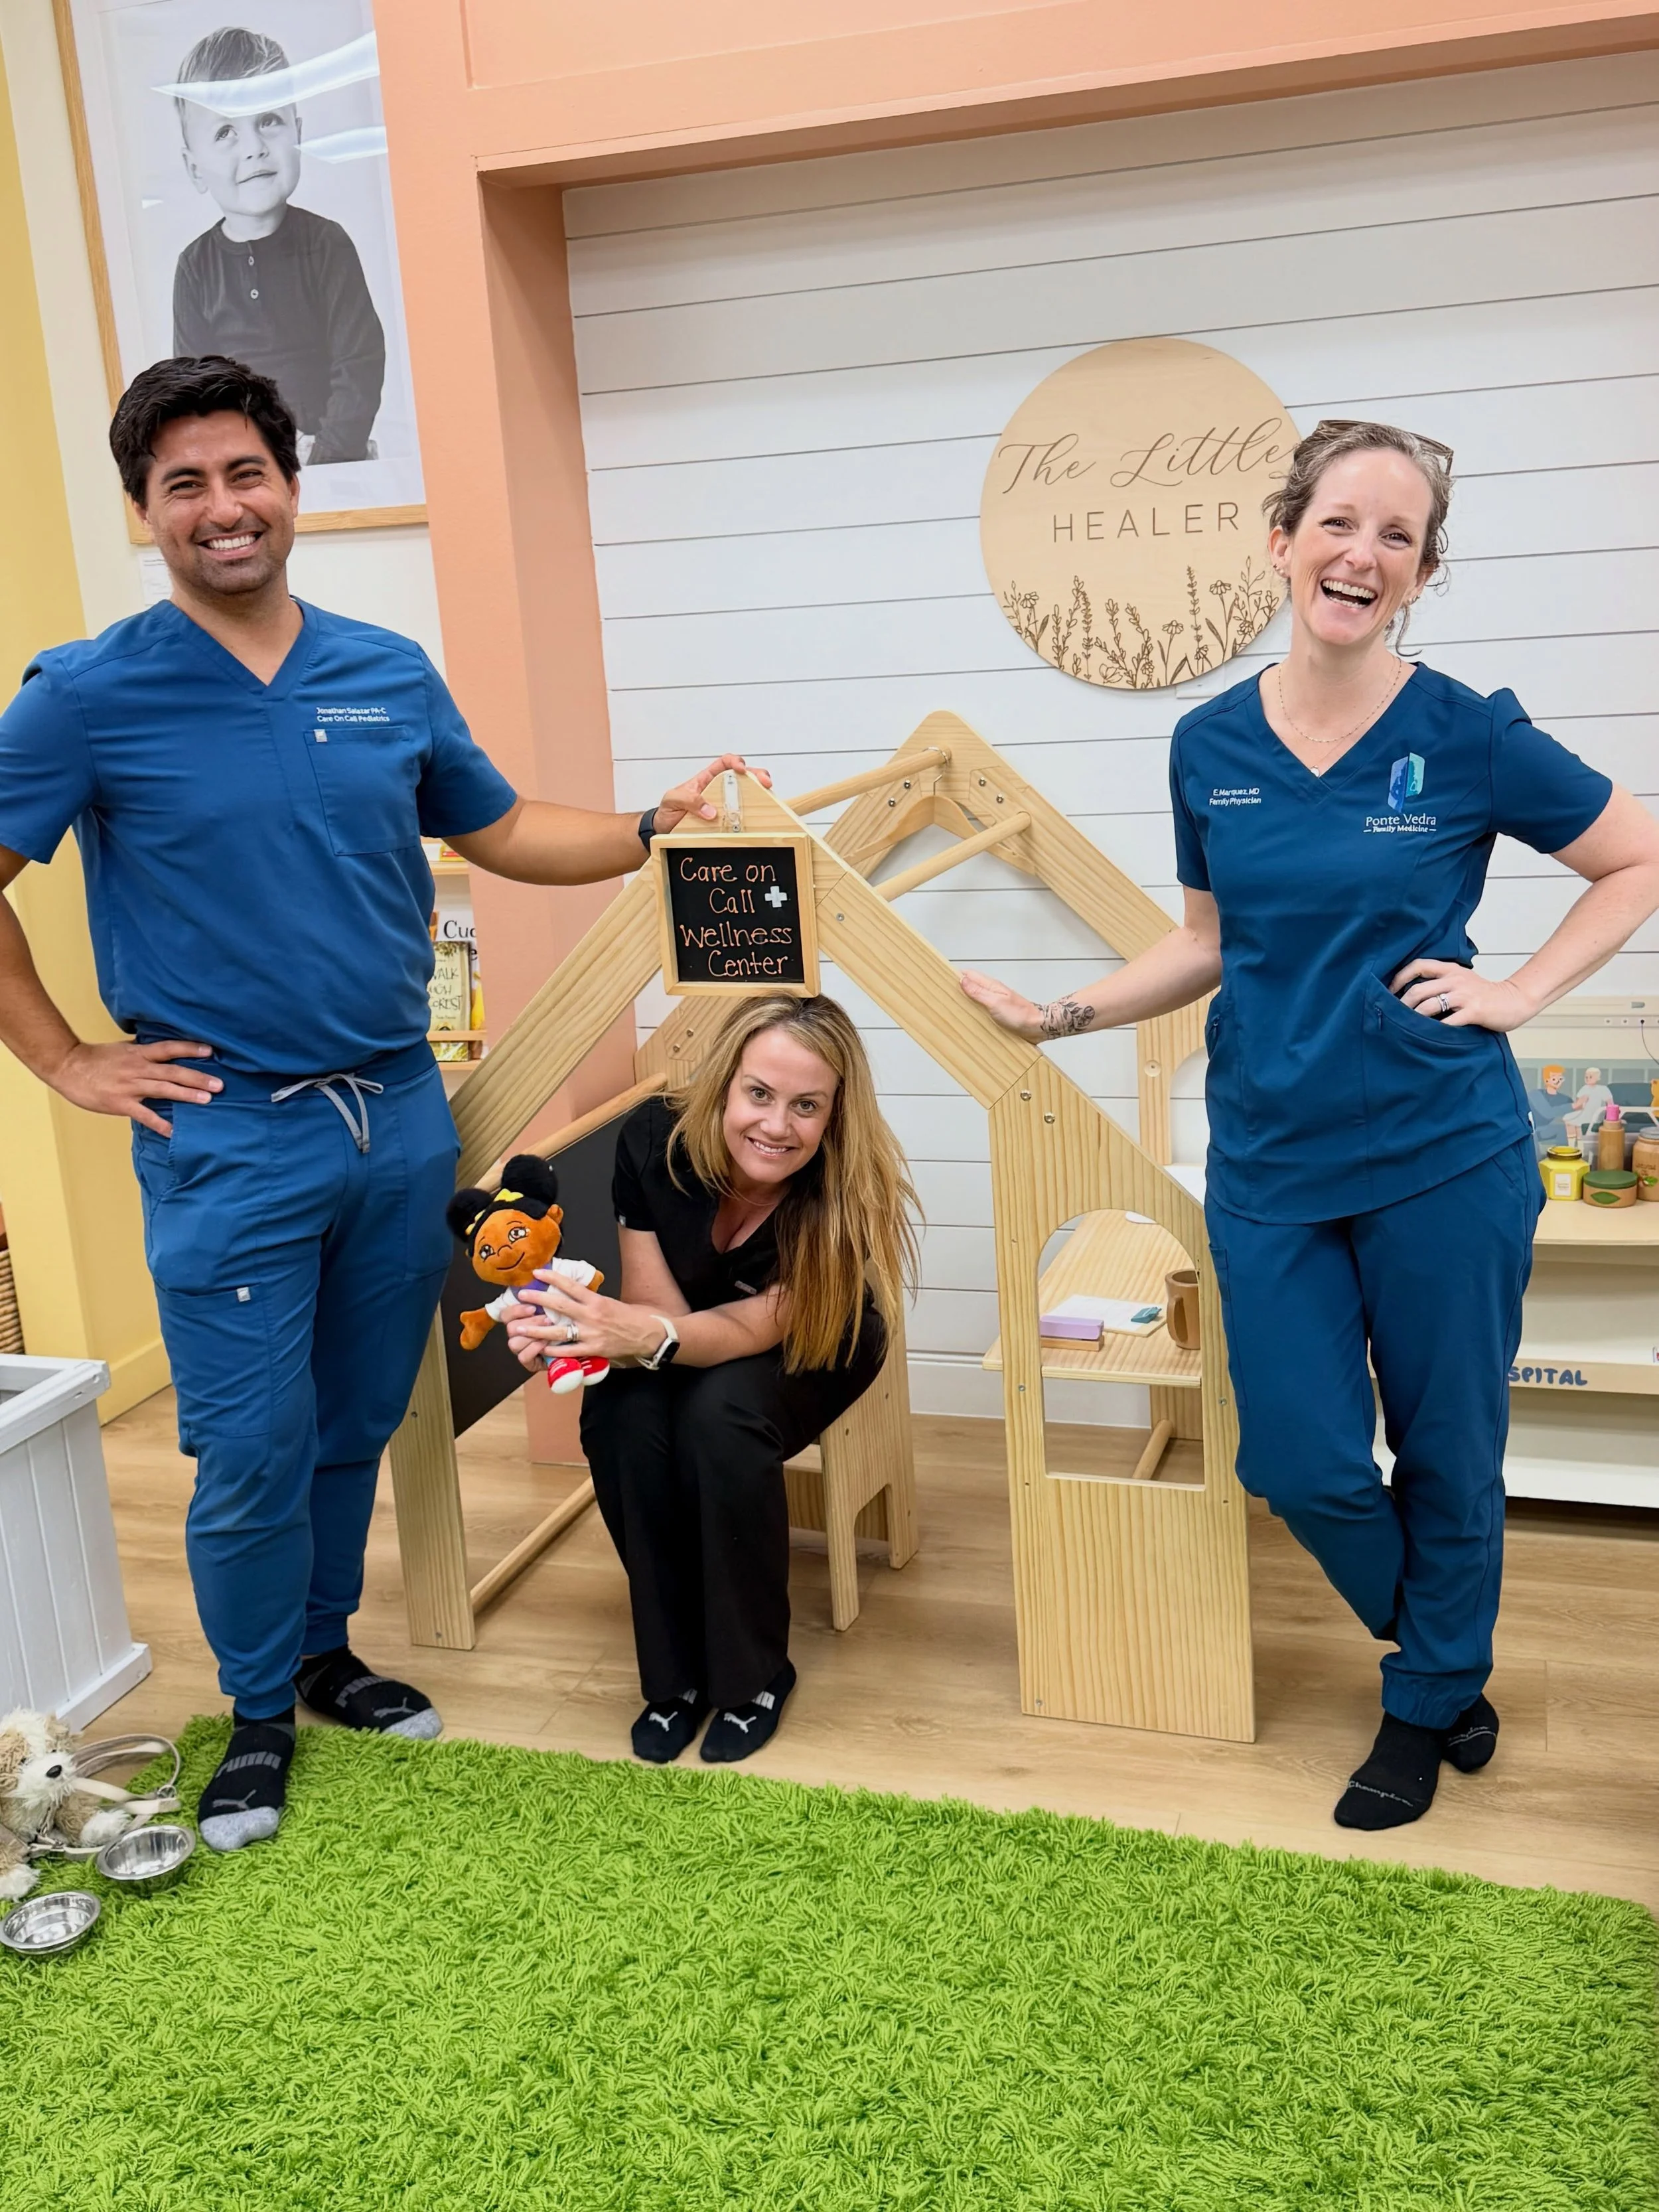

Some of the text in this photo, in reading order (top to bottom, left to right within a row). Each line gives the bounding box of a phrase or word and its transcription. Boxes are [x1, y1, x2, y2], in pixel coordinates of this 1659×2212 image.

[998, 417, 1298, 494] The Little
[1053, 502, 1239, 544] HEALER
[1209, 797, 1262, 806] Family Physician
[1366, 813, 1437, 827] Ponte Vedra
[680, 857, 776, 882] Care on
[709, 887, 755, 914] Call
[680, 921, 792, 948] Wellness
[708, 950, 788, 976] Center
[1508, 1366, 1588, 1386] SPITAL
